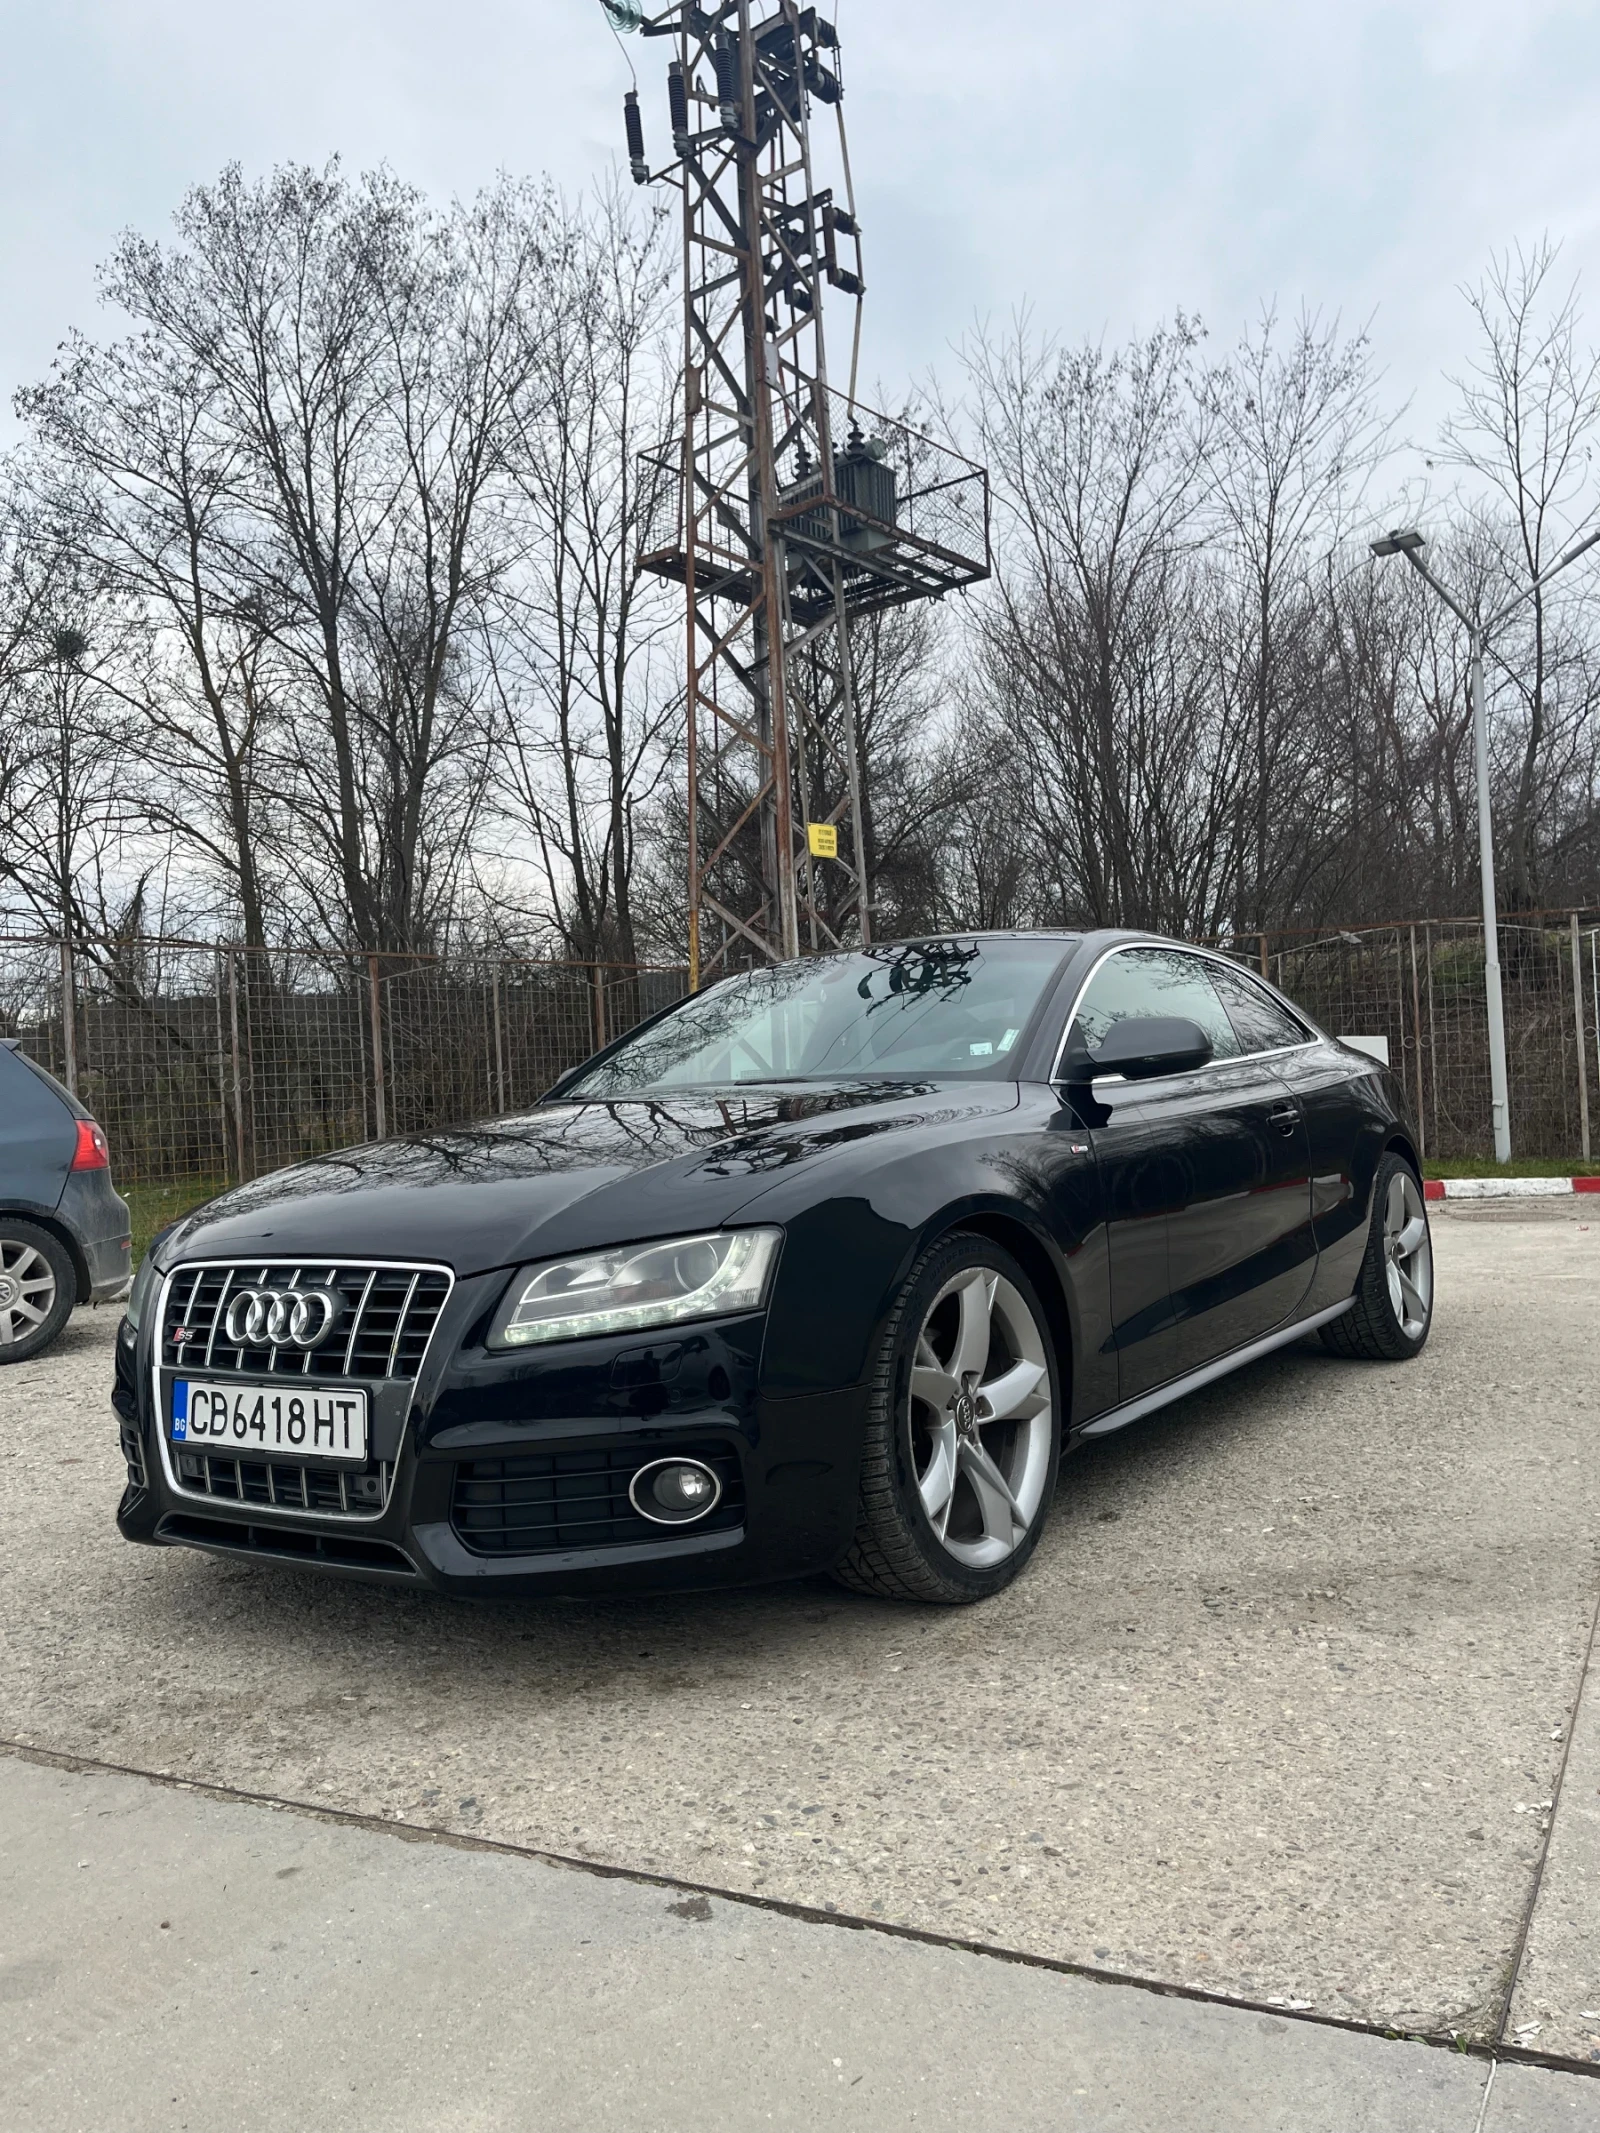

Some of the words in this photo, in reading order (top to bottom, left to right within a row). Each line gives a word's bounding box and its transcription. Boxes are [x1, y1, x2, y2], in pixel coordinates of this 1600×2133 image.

[177, 1329, 195, 1341] S5
[174, 1417, 186, 1432] BG
[190, 1389, 356, 1449] CB6418HT
